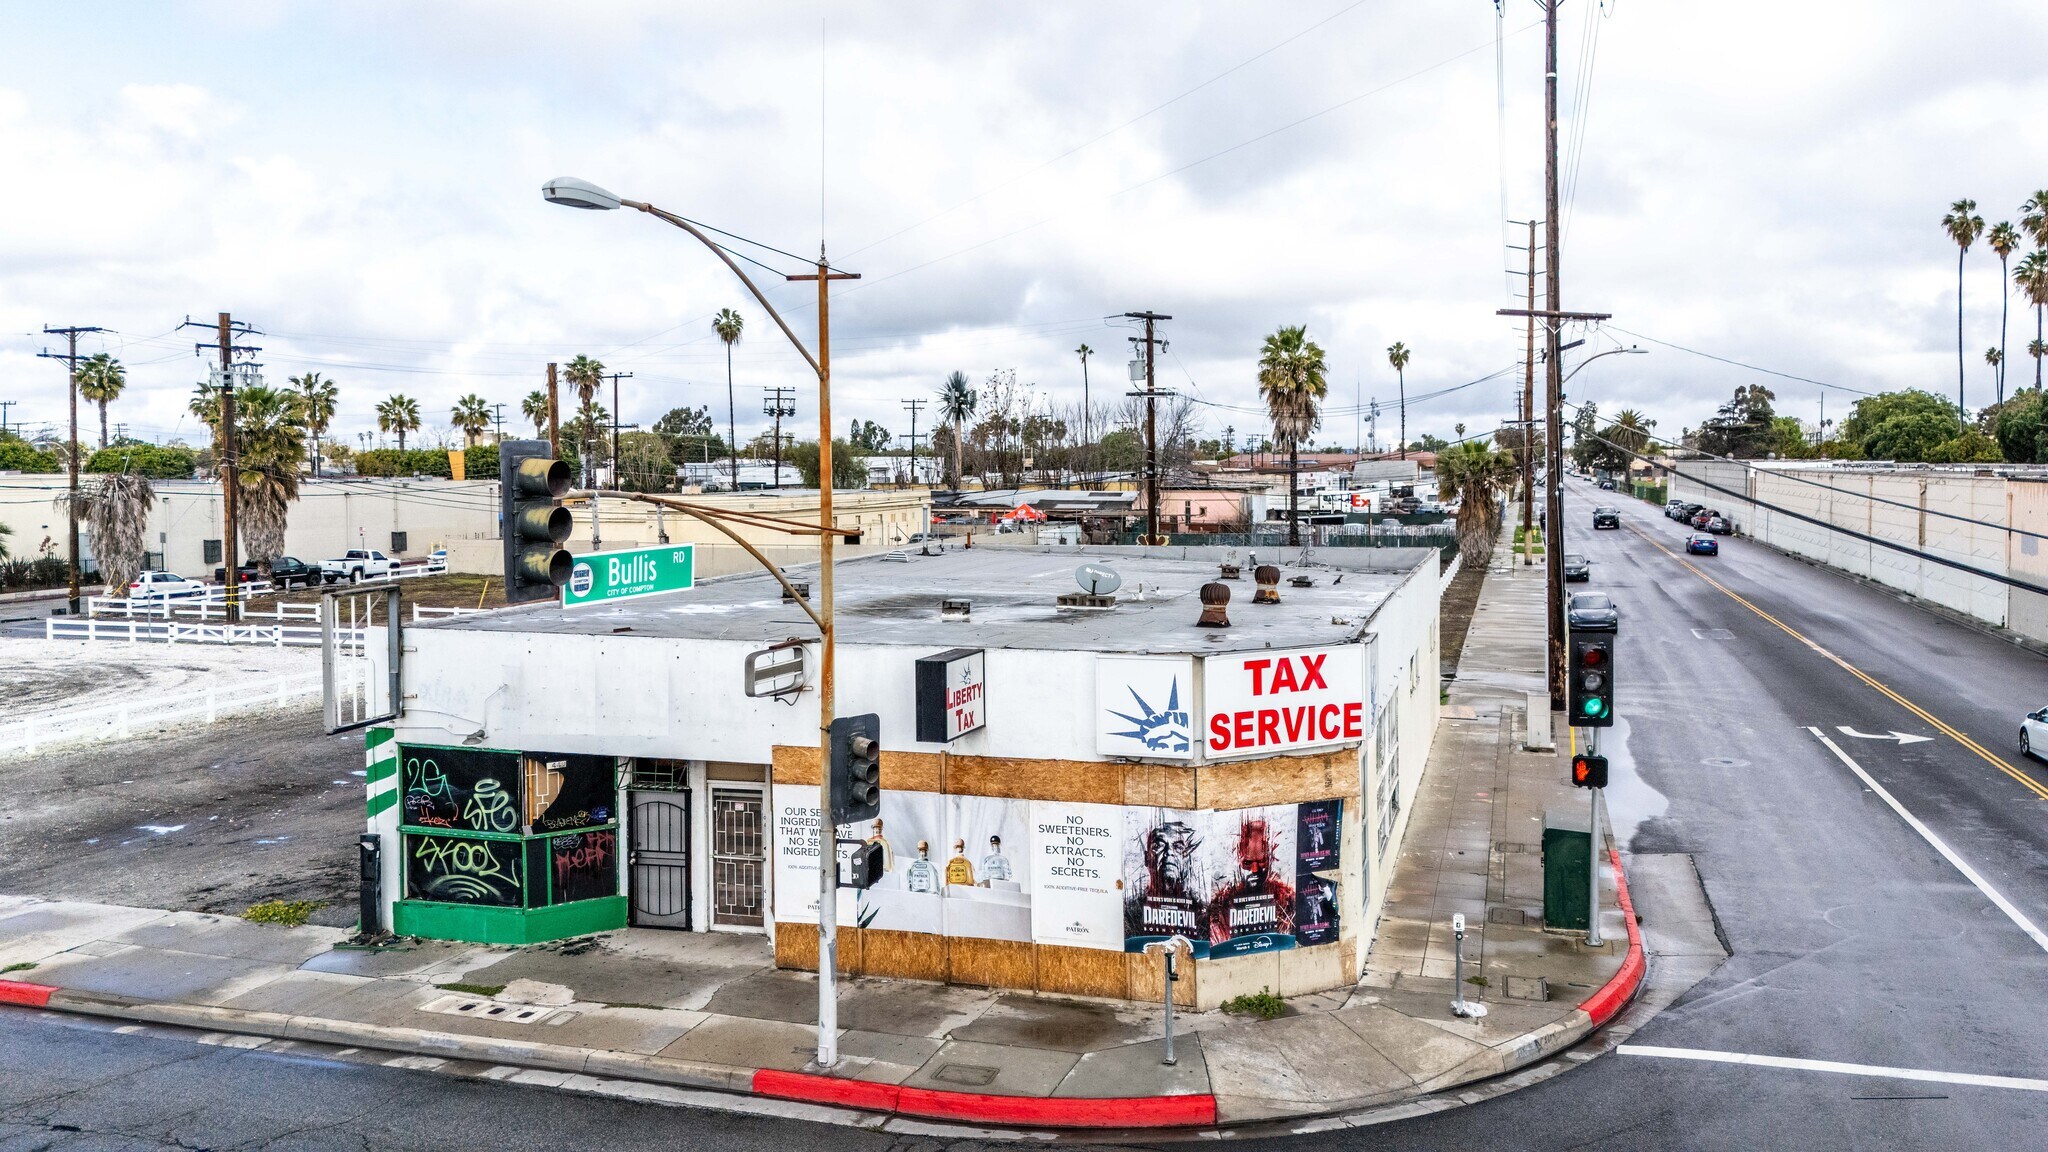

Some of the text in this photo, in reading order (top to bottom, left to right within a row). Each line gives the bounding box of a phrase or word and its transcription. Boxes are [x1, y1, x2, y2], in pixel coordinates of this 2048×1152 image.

[608, 550, 685, 586] Bullis RD
[606, 583, 654, 597] CITY OF COMPTON
[1243, 654, 1328, 696] TAX
[946, 681, 982, 711] LIBERTY
[1209, 702, 1363, 751] SERVICE
[784, 807, 807, 816] OUR
[1066, 815, 1083, 825] NO
[779, 827, 806, 836] THAT
[836, 830, 853, 839] AVE
[1038, 824, 1112, 838] SWEETENERS.
[788, 837, 805, 846] NO
[1066, 836, 1084, 846] NO
[1045, 845, 1106, 858] EXTRACTS.
[1067, 857, 1084, 867] NO
[1051, 866, 1101, 879] SECRETS.
[1143, 906, 1197, 929] DAREDEVIL
[1229, 905, 1278, 927] DAREDEVIL
